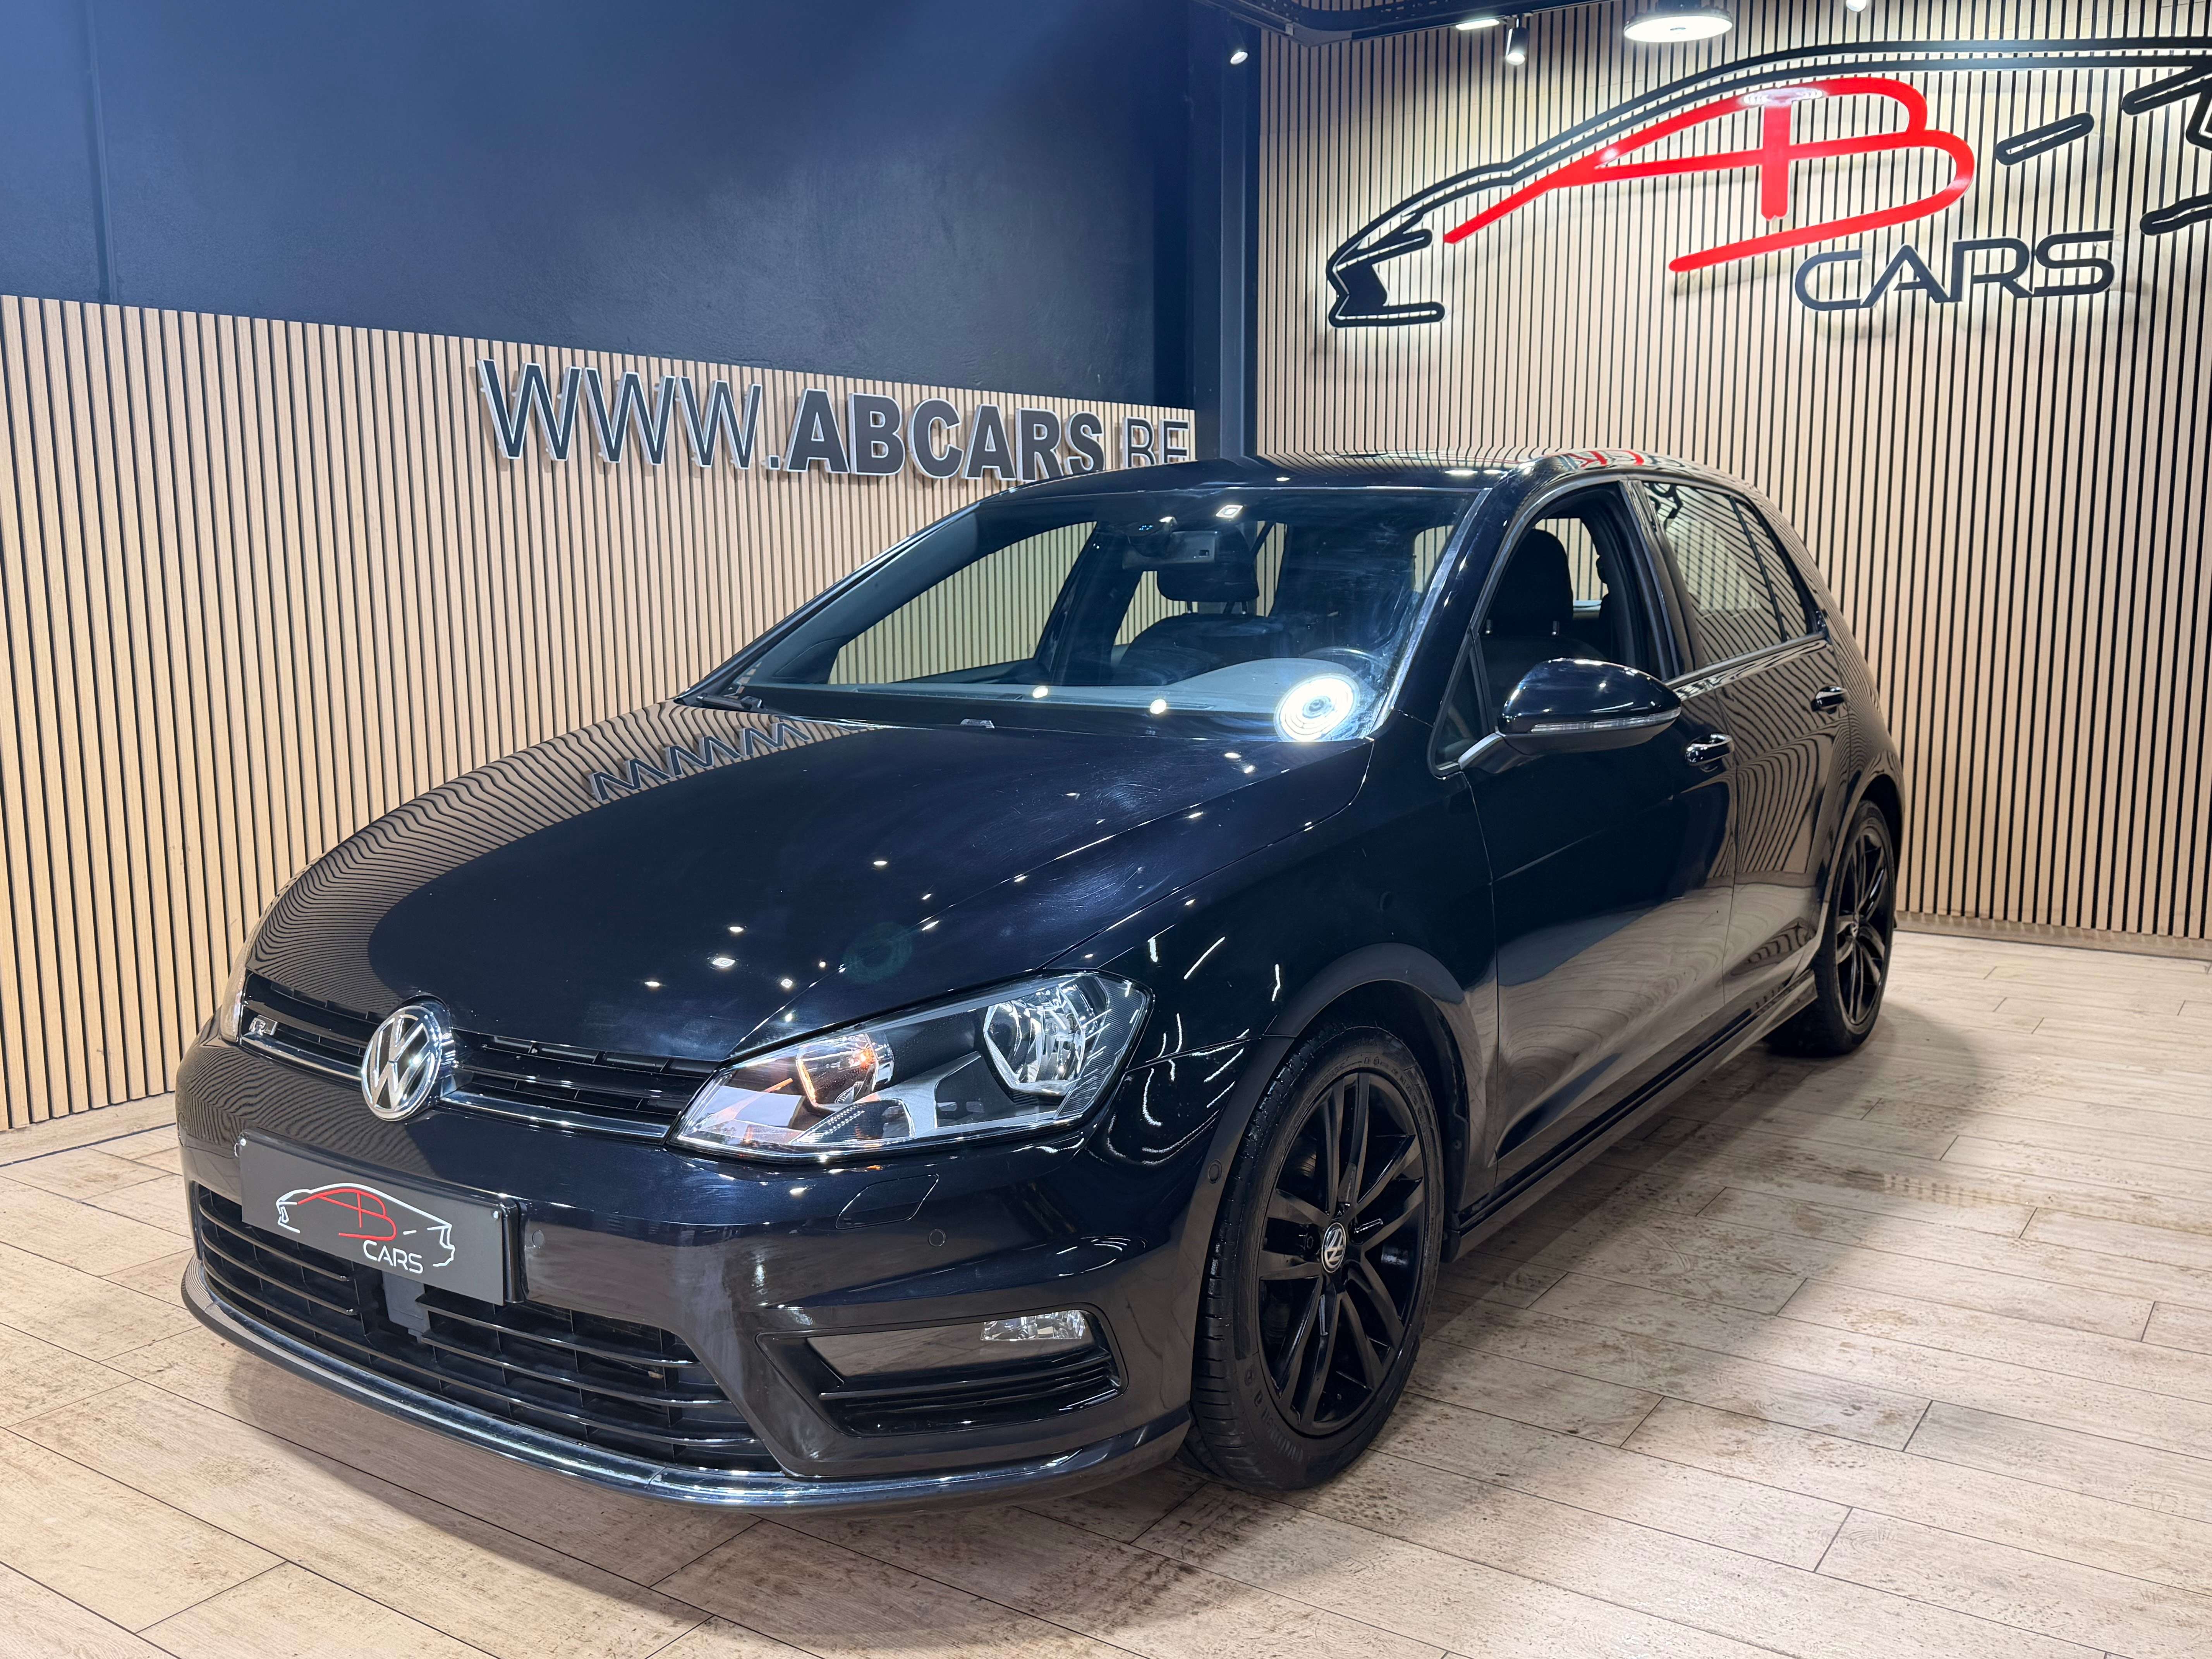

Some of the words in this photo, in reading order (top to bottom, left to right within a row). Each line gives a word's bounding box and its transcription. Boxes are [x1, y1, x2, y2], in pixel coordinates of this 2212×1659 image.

[1795, 230, 2114, 312] CARS
[477, 359, 1189, 480] WWW.ABCARSBE
[363, 1240, 423, 1274] CARS
